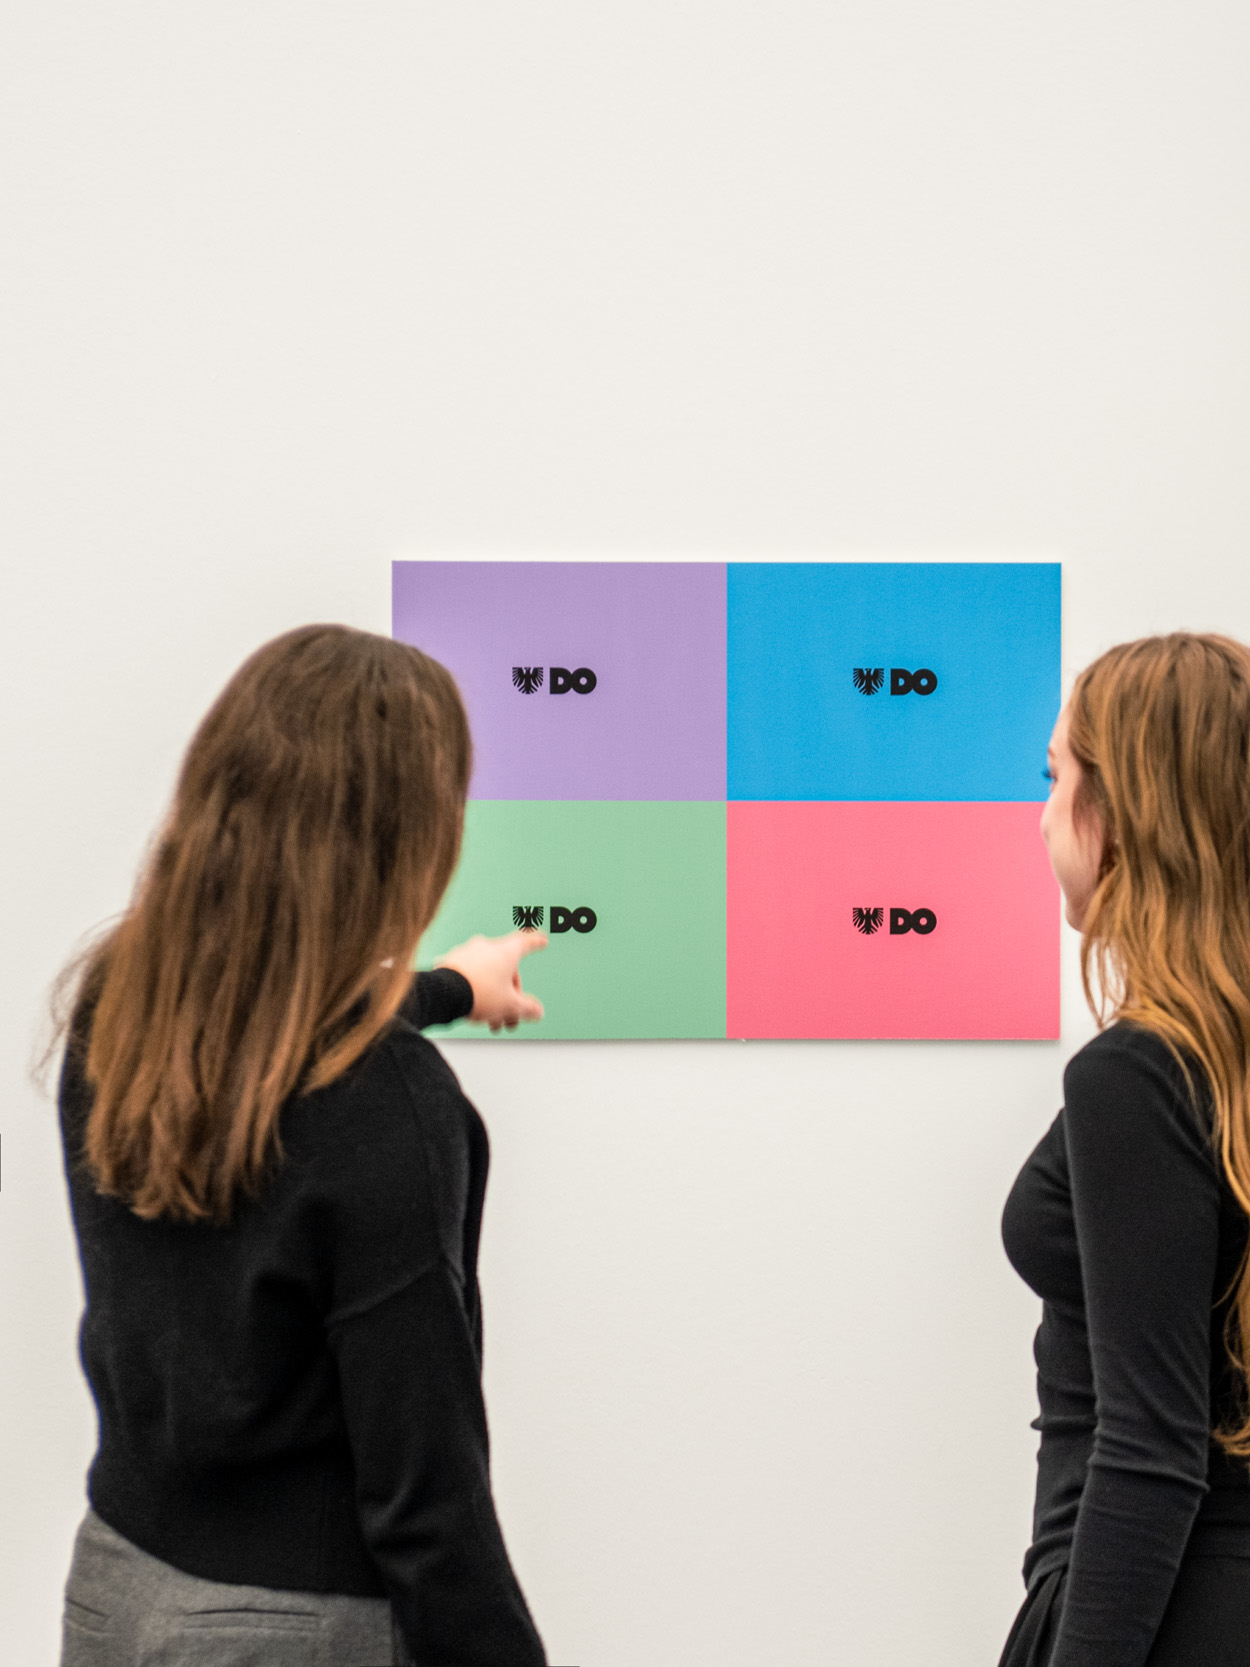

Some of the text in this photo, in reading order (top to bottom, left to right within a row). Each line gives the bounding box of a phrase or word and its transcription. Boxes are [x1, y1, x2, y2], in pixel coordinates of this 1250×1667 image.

[549, 667, 597, 695] DO
[889, 668, 938, 696] DO
[549, 906, 597, 934] DO
[889, 907, 937, 935] DO
